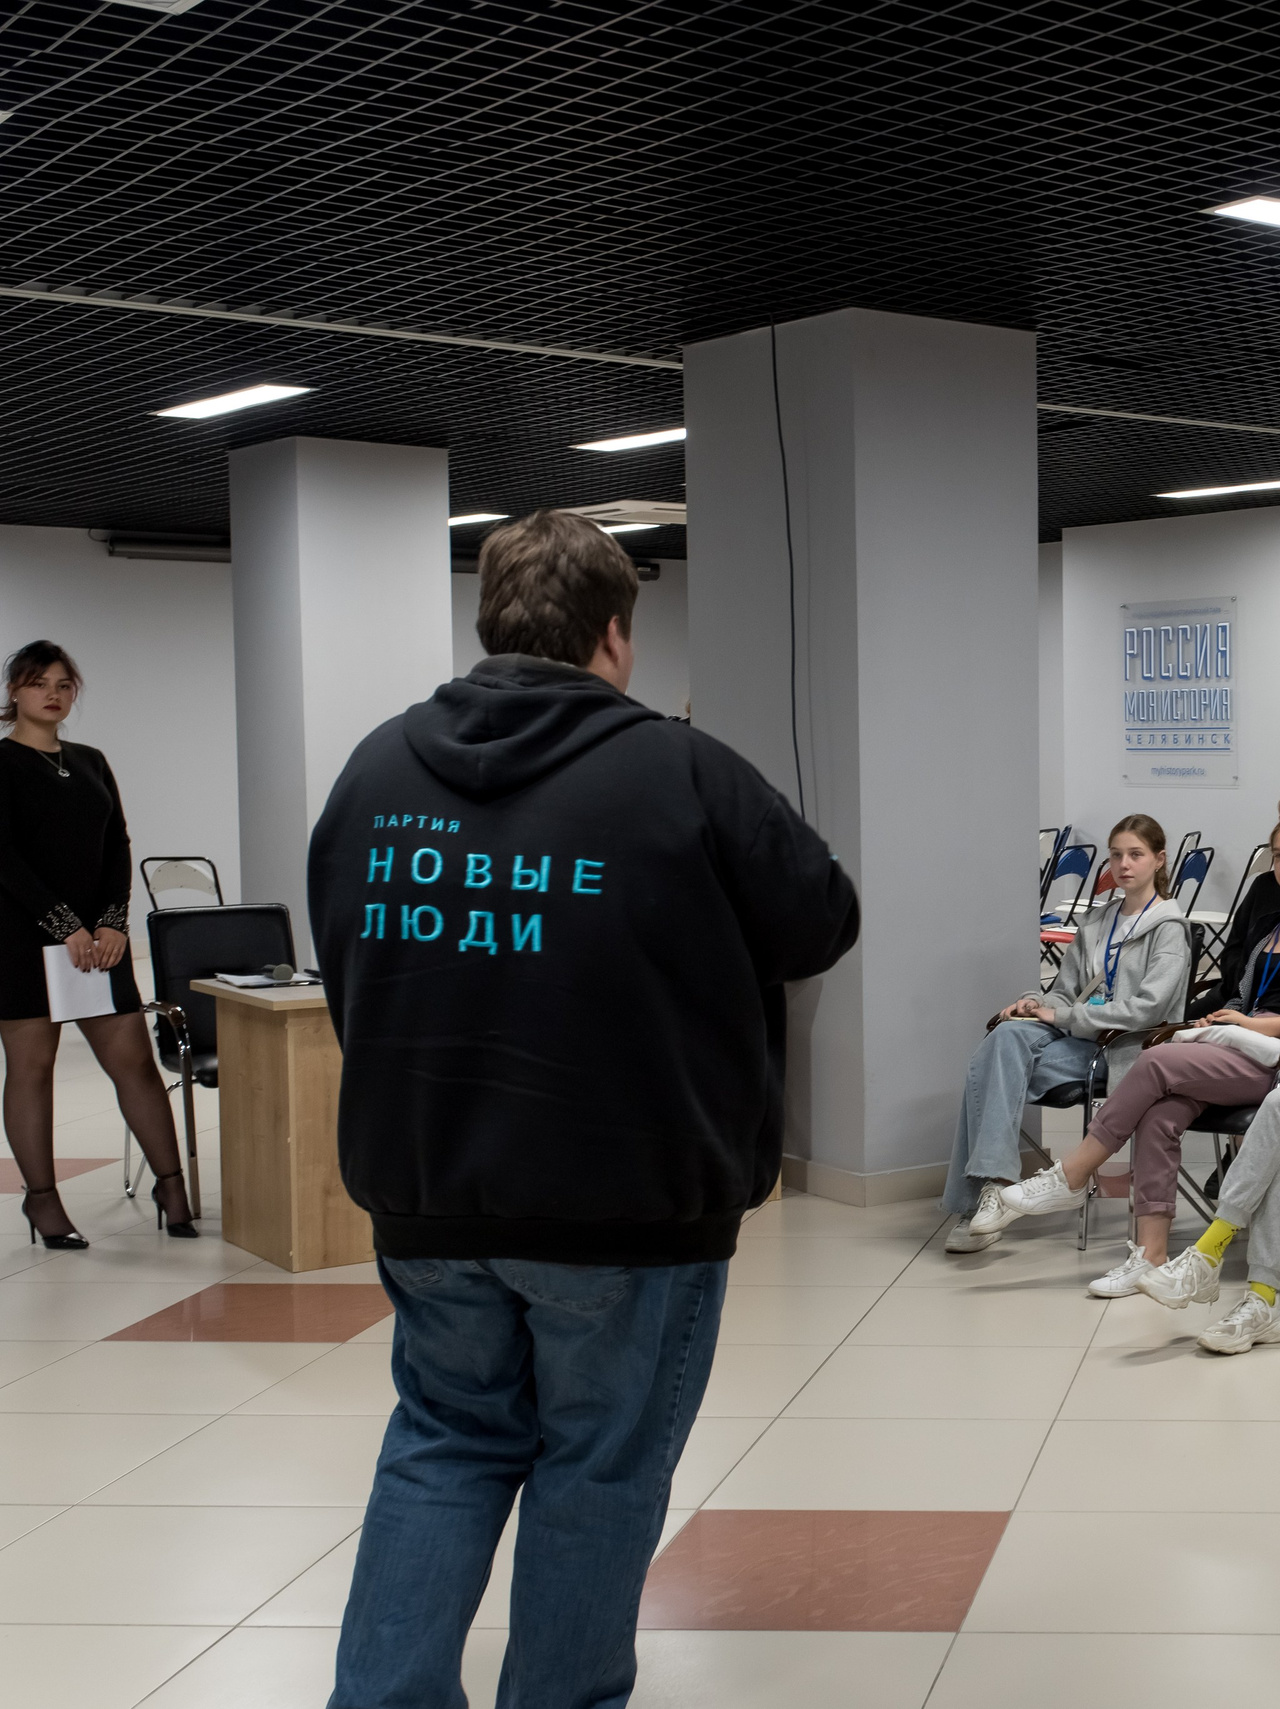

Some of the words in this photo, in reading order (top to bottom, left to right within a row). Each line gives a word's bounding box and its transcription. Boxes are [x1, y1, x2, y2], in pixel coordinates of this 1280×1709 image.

[1124, 622, 1231, 682] РОССИЯ
[1124, 689, 1157, 722] МОЯ
[1161, 687, 1231, 722] ИСТОРИЯ
[1125, 733, 1231, 745] ЧЕЛЯБИНСК
[1150, 765, 1205, 778] myhistorypark.ru
[373, 814, 462, 833] ПАРТИЯ
[366, 846, 606, 895] НОВЫЕ
[360, 903, 543, 955] ЛЮДИ
